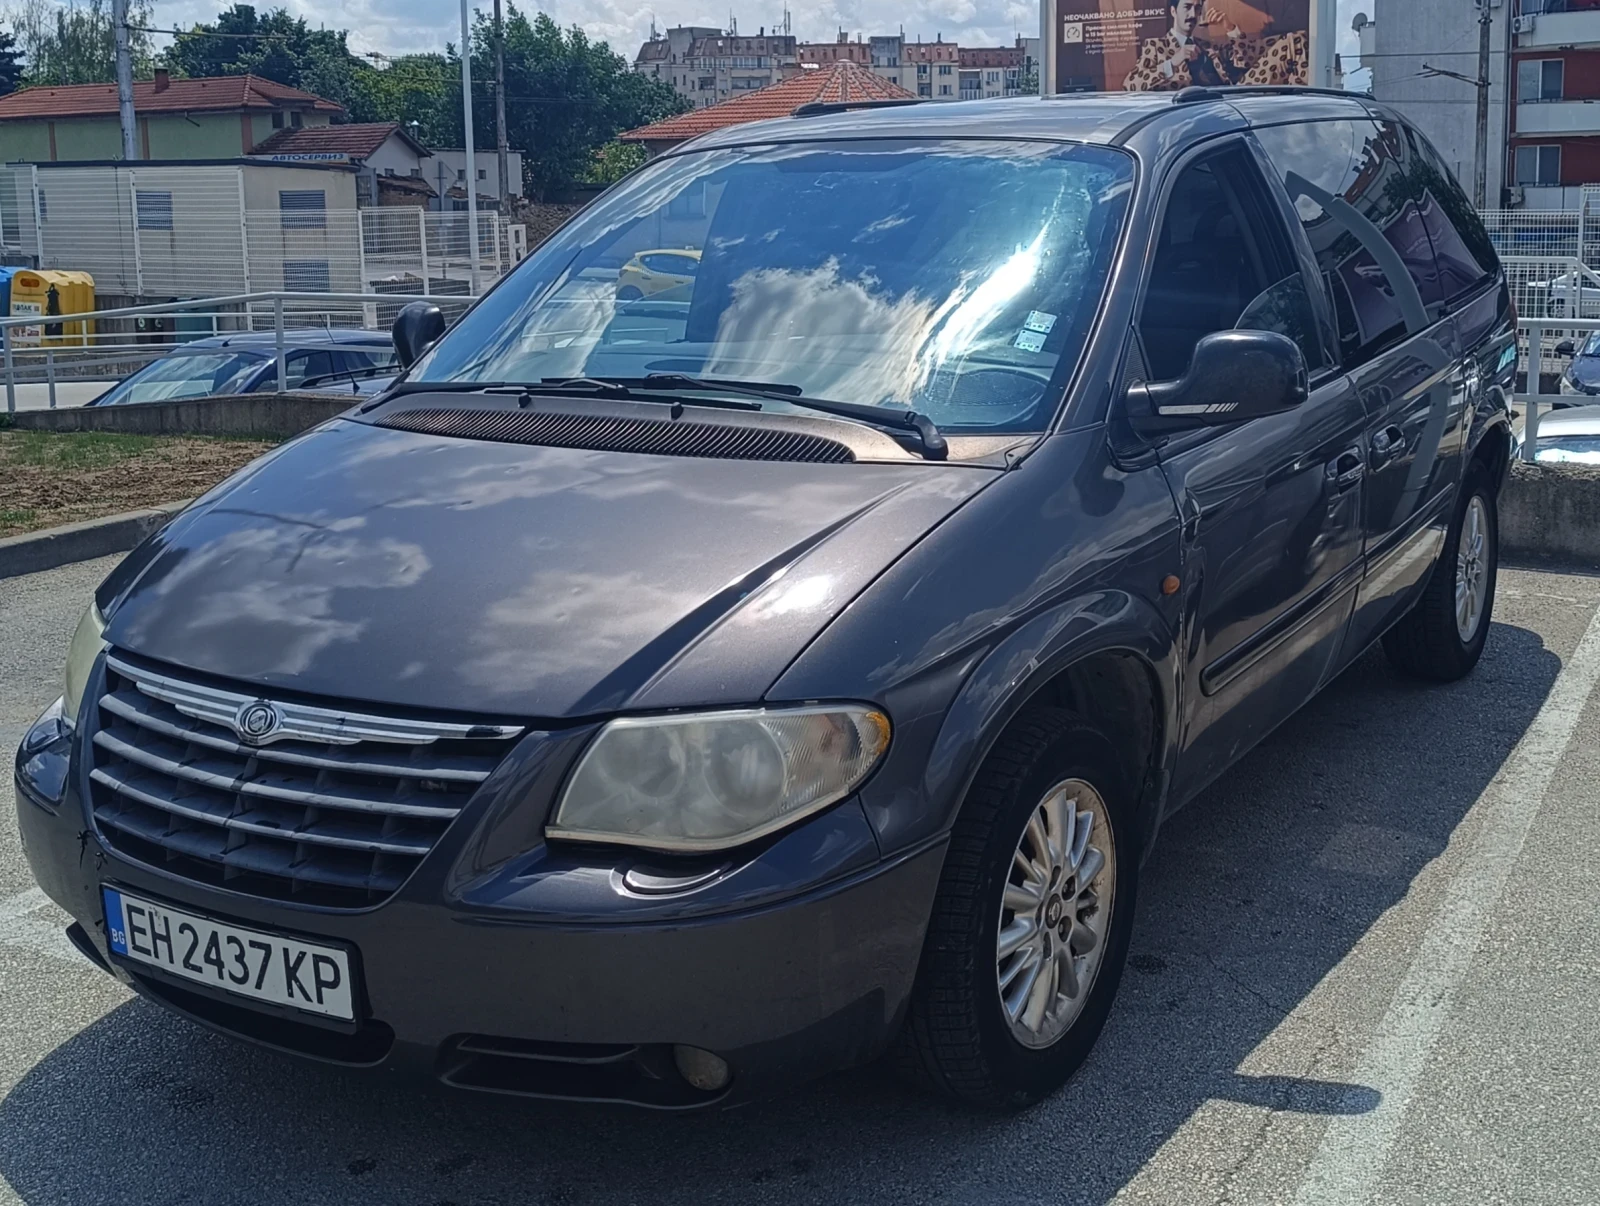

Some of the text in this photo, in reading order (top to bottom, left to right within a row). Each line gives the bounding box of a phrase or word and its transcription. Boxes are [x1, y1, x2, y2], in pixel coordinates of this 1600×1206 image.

[1064, 12, 1114, 21] НЕОЧАКВАНО
[1116, 10, 1143, 18] ДОБЪР
[271, 153, 344, 161] АВТОСЕРВИЗ
[111, 928, 125, 945] BG
